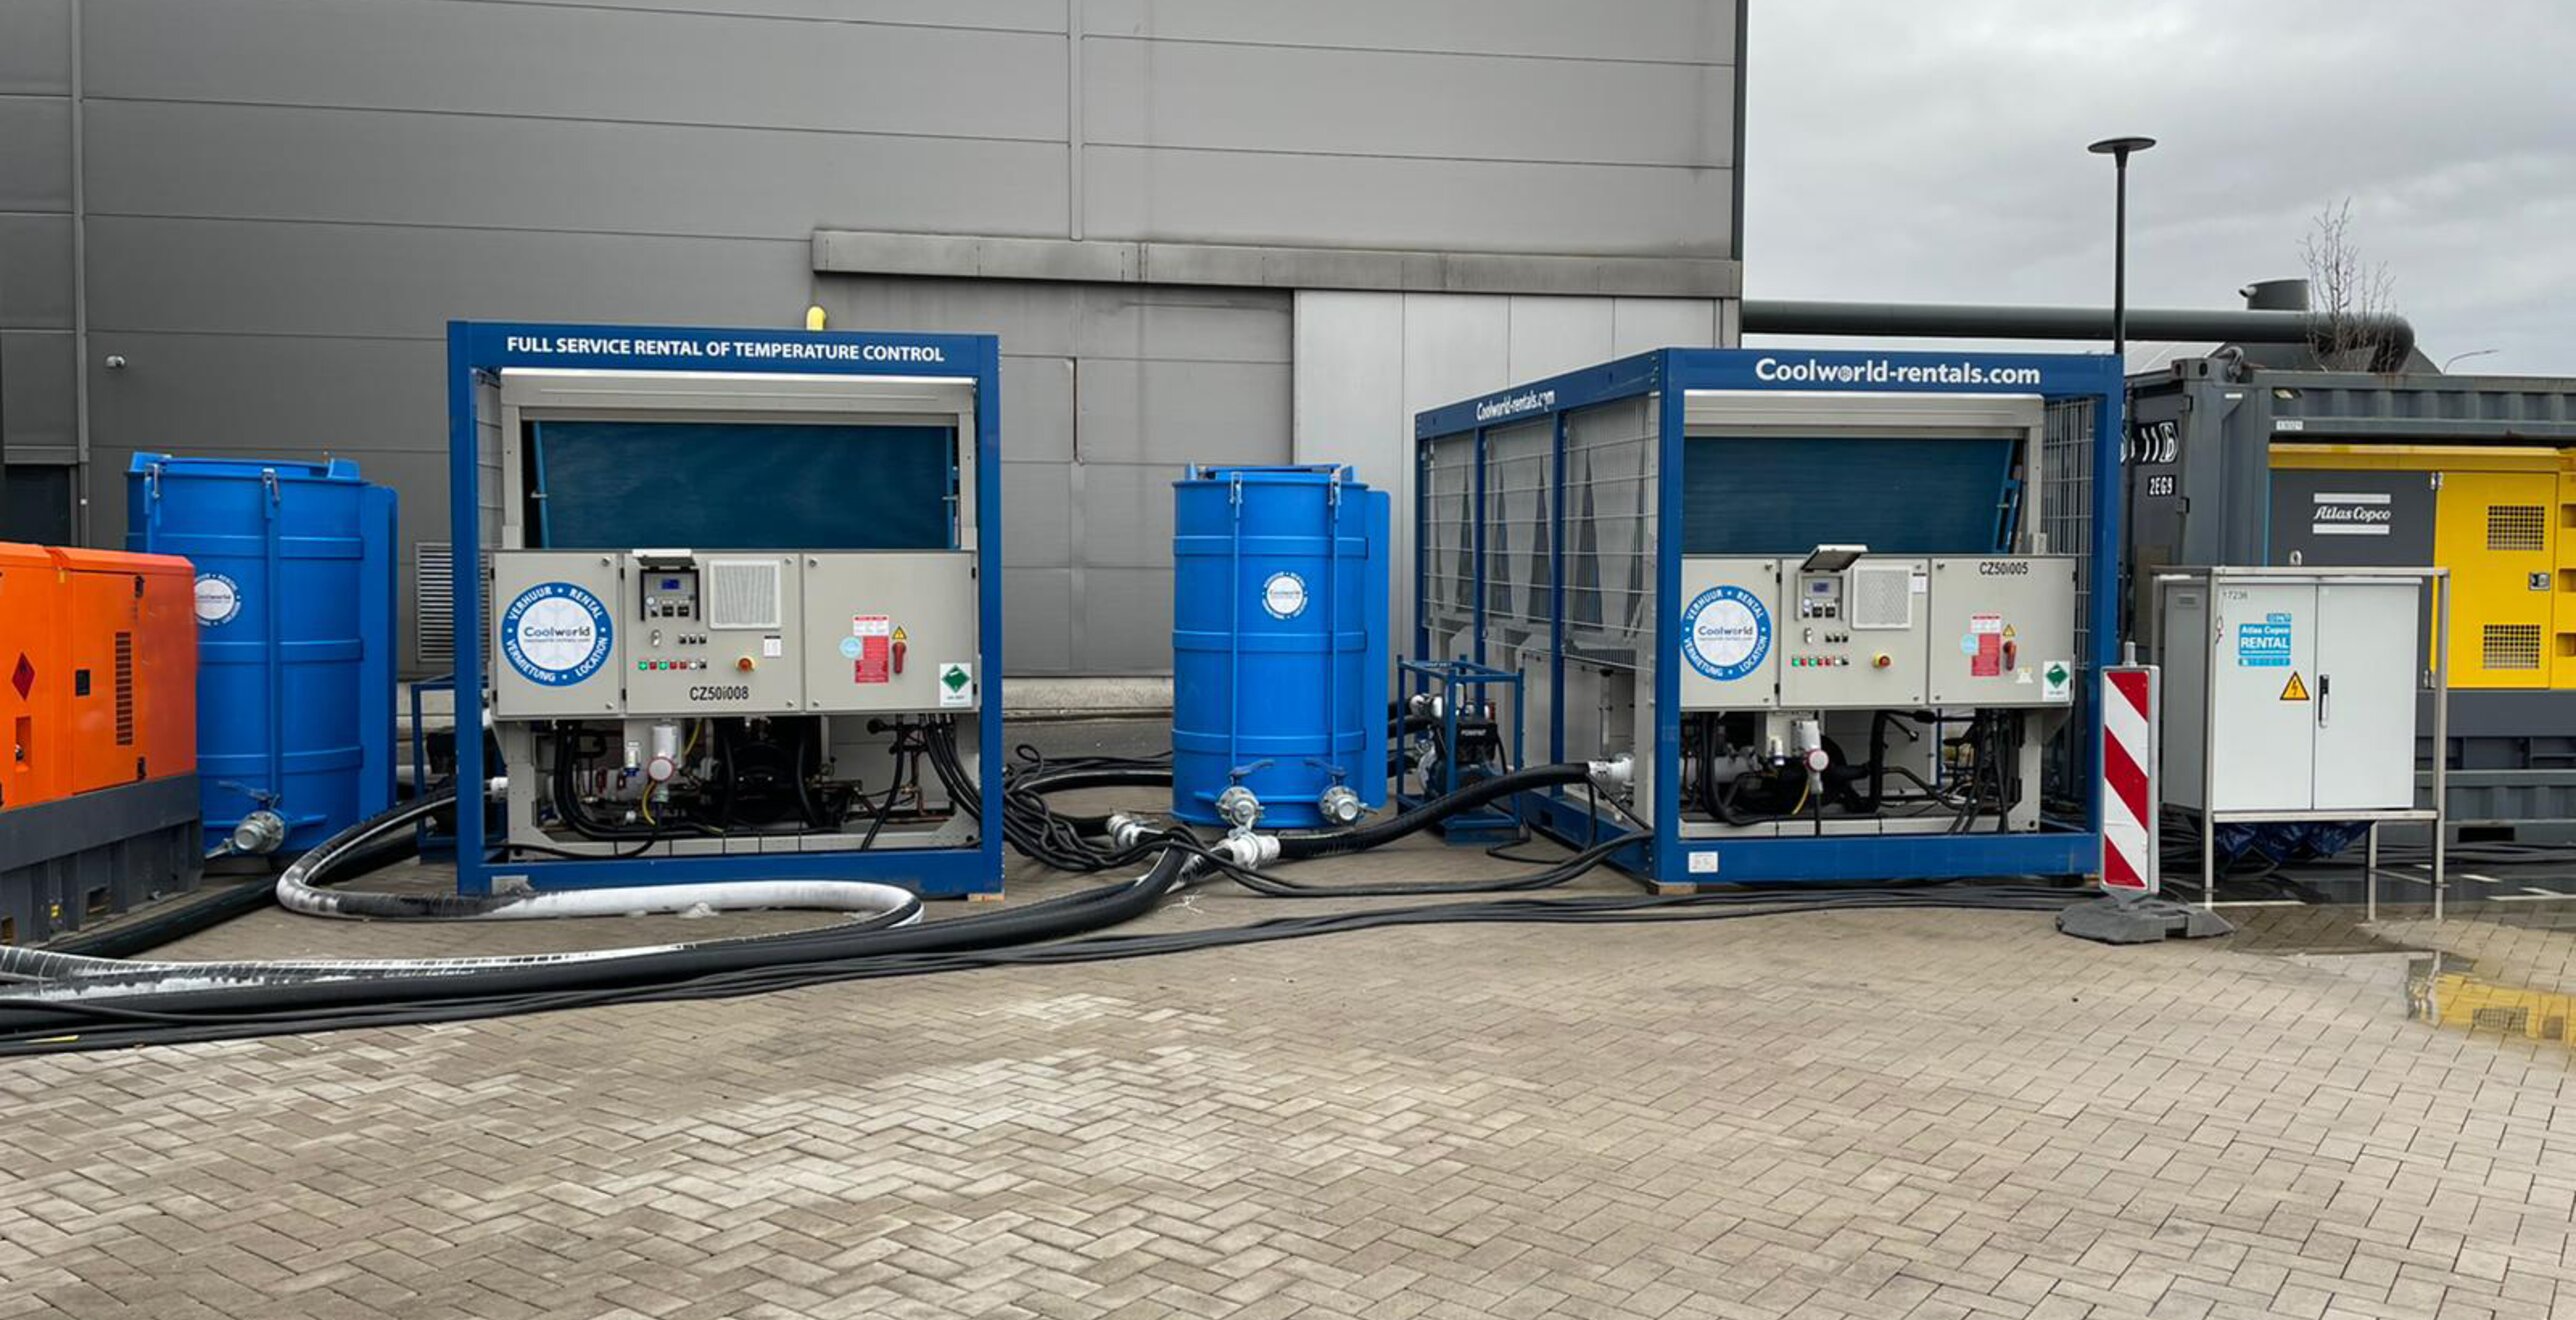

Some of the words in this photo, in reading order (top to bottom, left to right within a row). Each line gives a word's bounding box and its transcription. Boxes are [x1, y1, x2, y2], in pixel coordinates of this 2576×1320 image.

[507, 336, 552, 352] FULL
[556, 337, 630, 354] SERVICE
[634, 339, 703, 356] RENTAL
[706, 341, 729, 356] OF
[733, 341, 859, 360] TEMPERATURE
[863, 345, 945, 362] CONTROL
[1755, 357, 2041, 384] Coolworld-rentals.com
[2313, 505, 2352, 520] Atlas
[2353, 505, 2391, 523] Copco
[507, 585, 553, 620] VERHUUR
[569, 587, 604, 619] RENTAL
[524, 626, 591, 637] Coolworld
[1697, 626, 1753, 636] Coolworld
[2240, 636, 2290, 649] RENTAL
[506, 638, 556, 682] VERMIETUNG
[575, 637, 609, 677] LOCATION
[689, 686, 749, 701] CZ50i008
